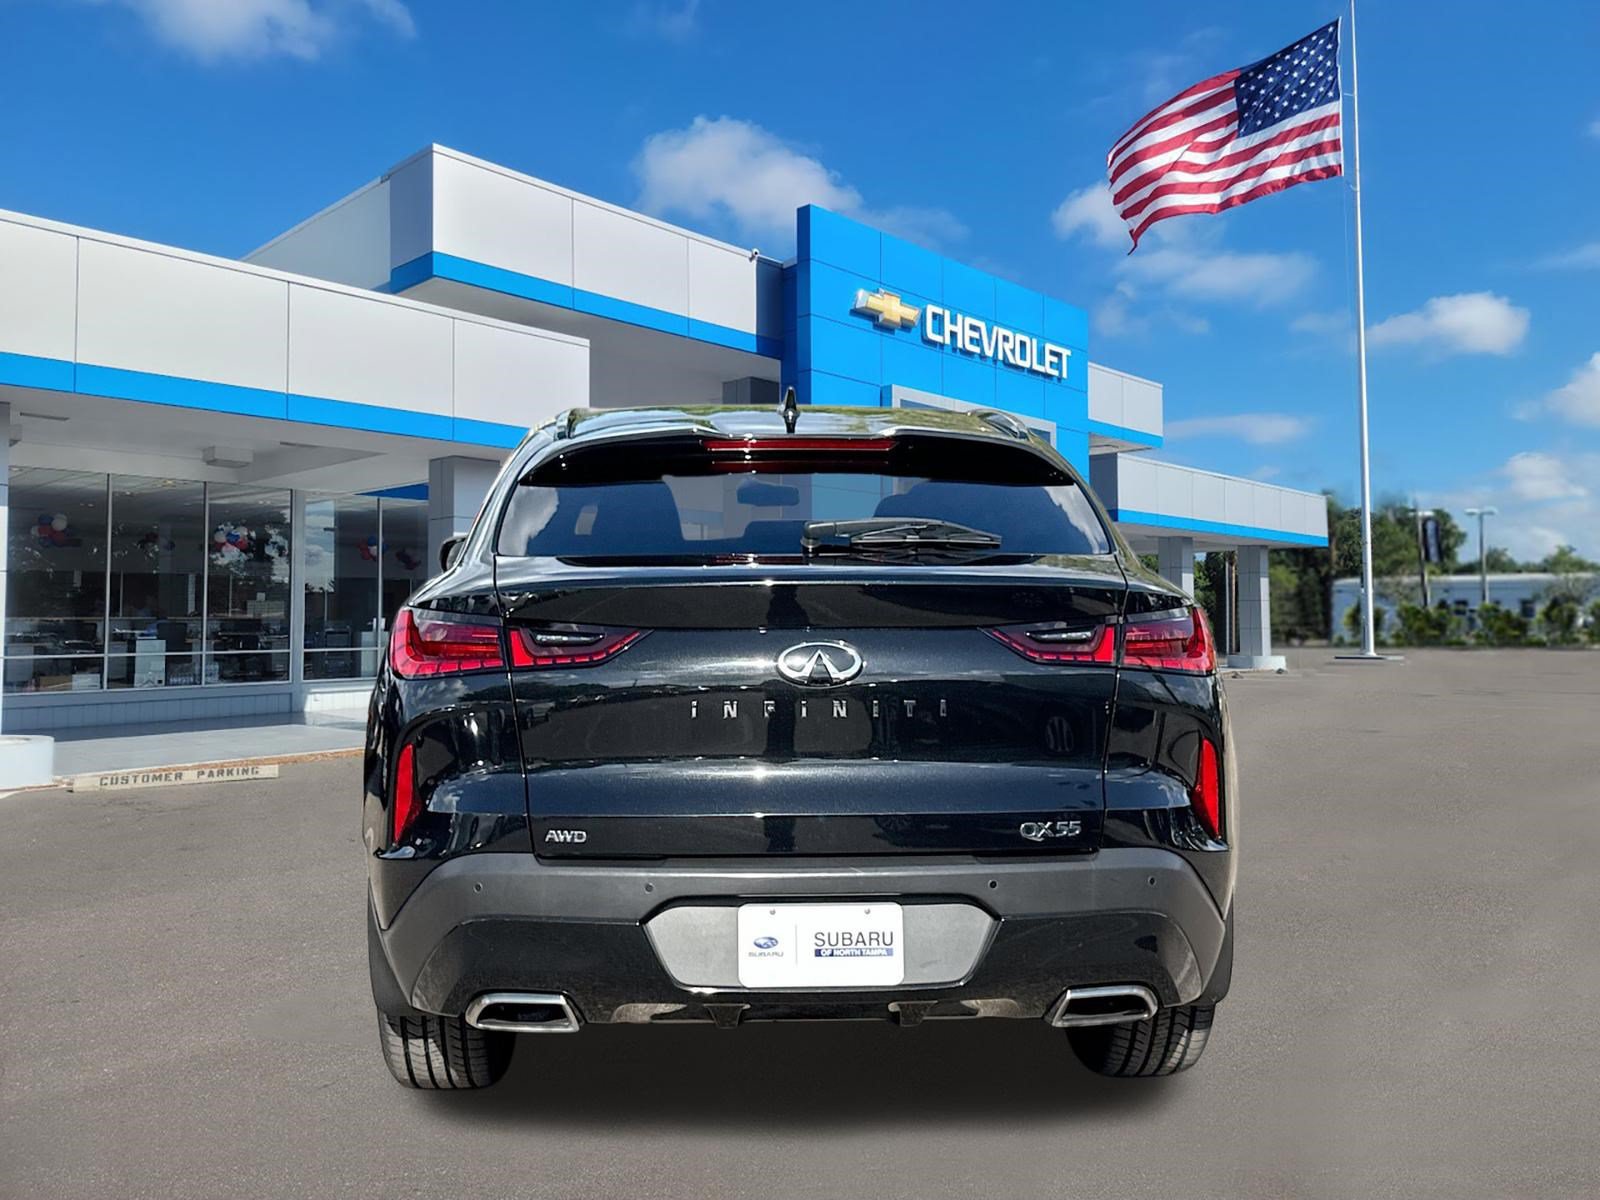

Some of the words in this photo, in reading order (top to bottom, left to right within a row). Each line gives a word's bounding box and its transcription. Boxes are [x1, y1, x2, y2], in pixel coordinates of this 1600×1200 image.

[925, 303, 1072, 379] CHEVROLET
[690, 699, 947, 719] INFINITI
[99, 771, 184, 787] CUSTOMER
[196, 766, 260, 779] PARKING
[545, 829, 587, 843] AWD
[1019, 820, 1082, 842] QX55
[814, 931, 894, 947] SUBARU
[820, 948, 832, 957] OF
[833, 948, 861, 957] NORTH
[862, 948, 888, 957] TAMPA
